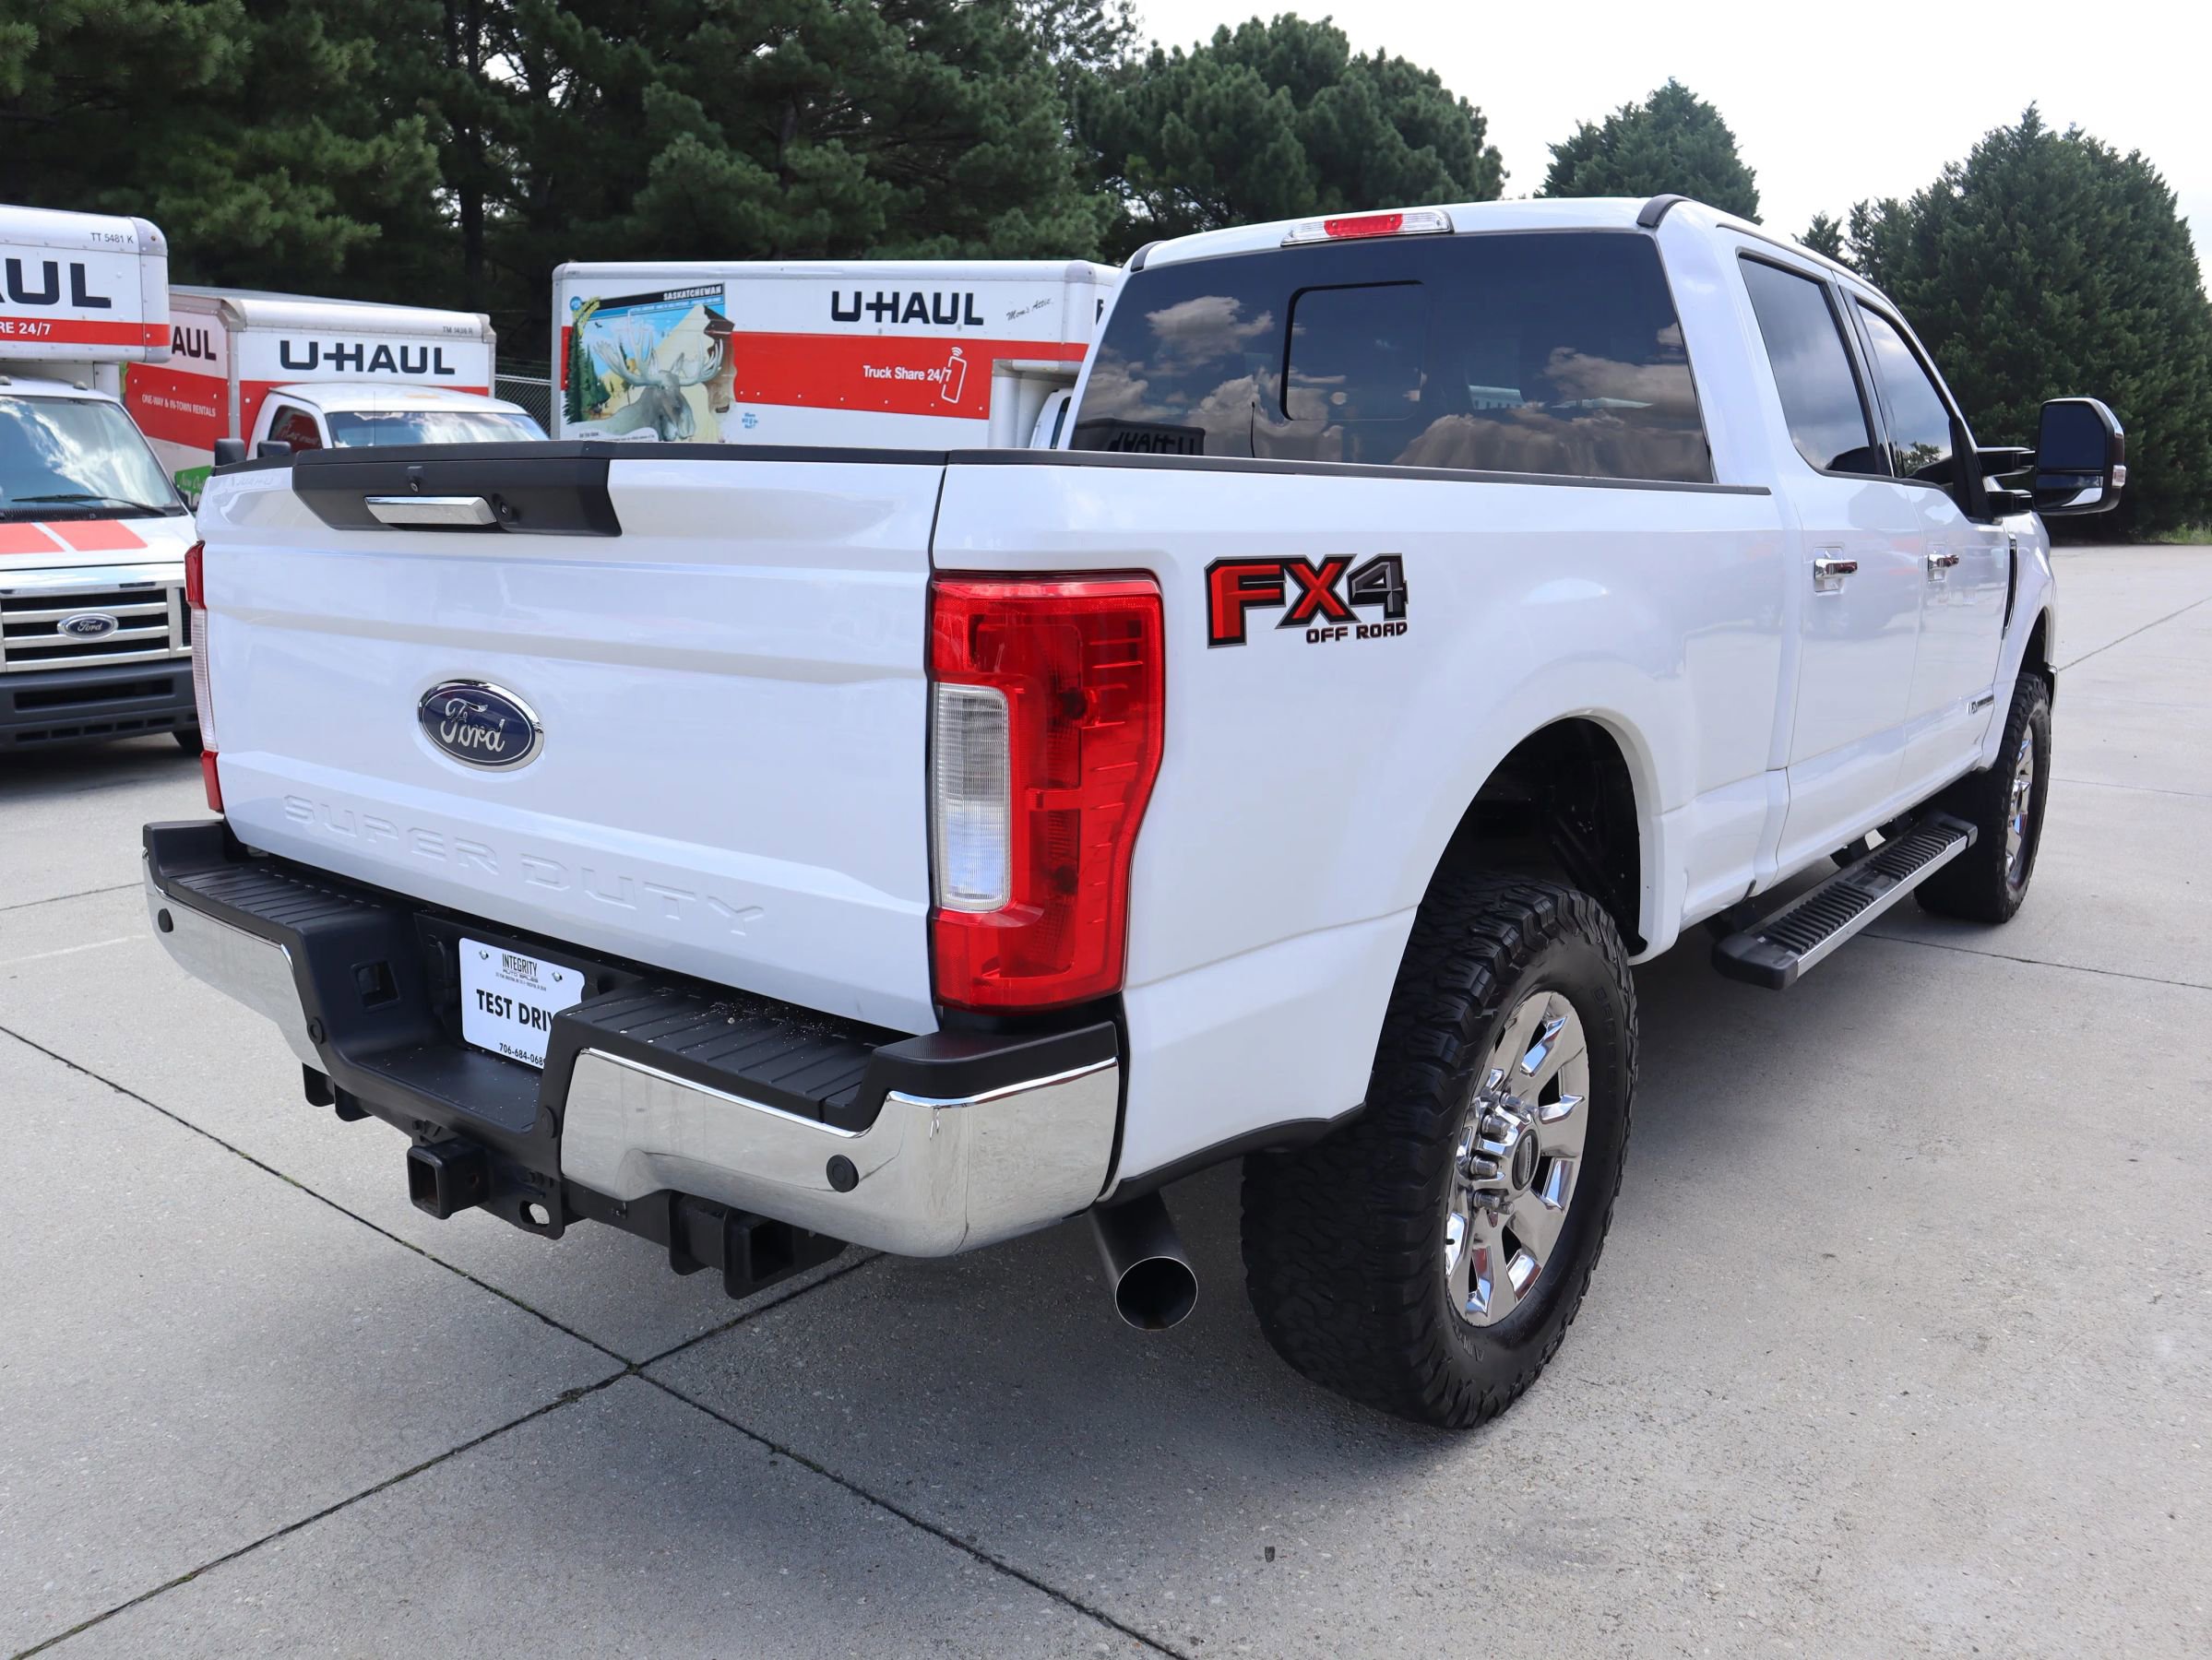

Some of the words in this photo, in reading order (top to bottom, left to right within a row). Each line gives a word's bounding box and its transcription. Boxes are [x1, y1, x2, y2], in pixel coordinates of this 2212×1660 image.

[90, 232, 101, 242] TT
[104, 233, 125, 243] 5481
[126, 235, 134, 243] K
[0, 258, 112, 309] UL
[663, 285, 721, 301] SASKATCHEWAN
[831, 290, 984, 326] U-HAUL
[18, 322, 52, 337] 24/7
[279, 339, 456, 375] U-HAUL
[862, 364, 892, 379] Truck
[894, 366, 925, 381] Share
[927, 366, 952, 385] 24/7
[193, 404, 217, 418] RENTALS
[1204, 553, 1409, 649] FX4
[77, 620, 103, 632] Ford
[1306, 627, 1349, 645] OFF
[1356, 622, 1408, 640] ROAD
[440, 697, 505, 753] Ford
[282, 793, 500, 876] SUPER
[521, 852, 765, 936] DUTY
[502, 953, 538, 977] INTEGRITY
[476, 989, 513, 1020] TEST
